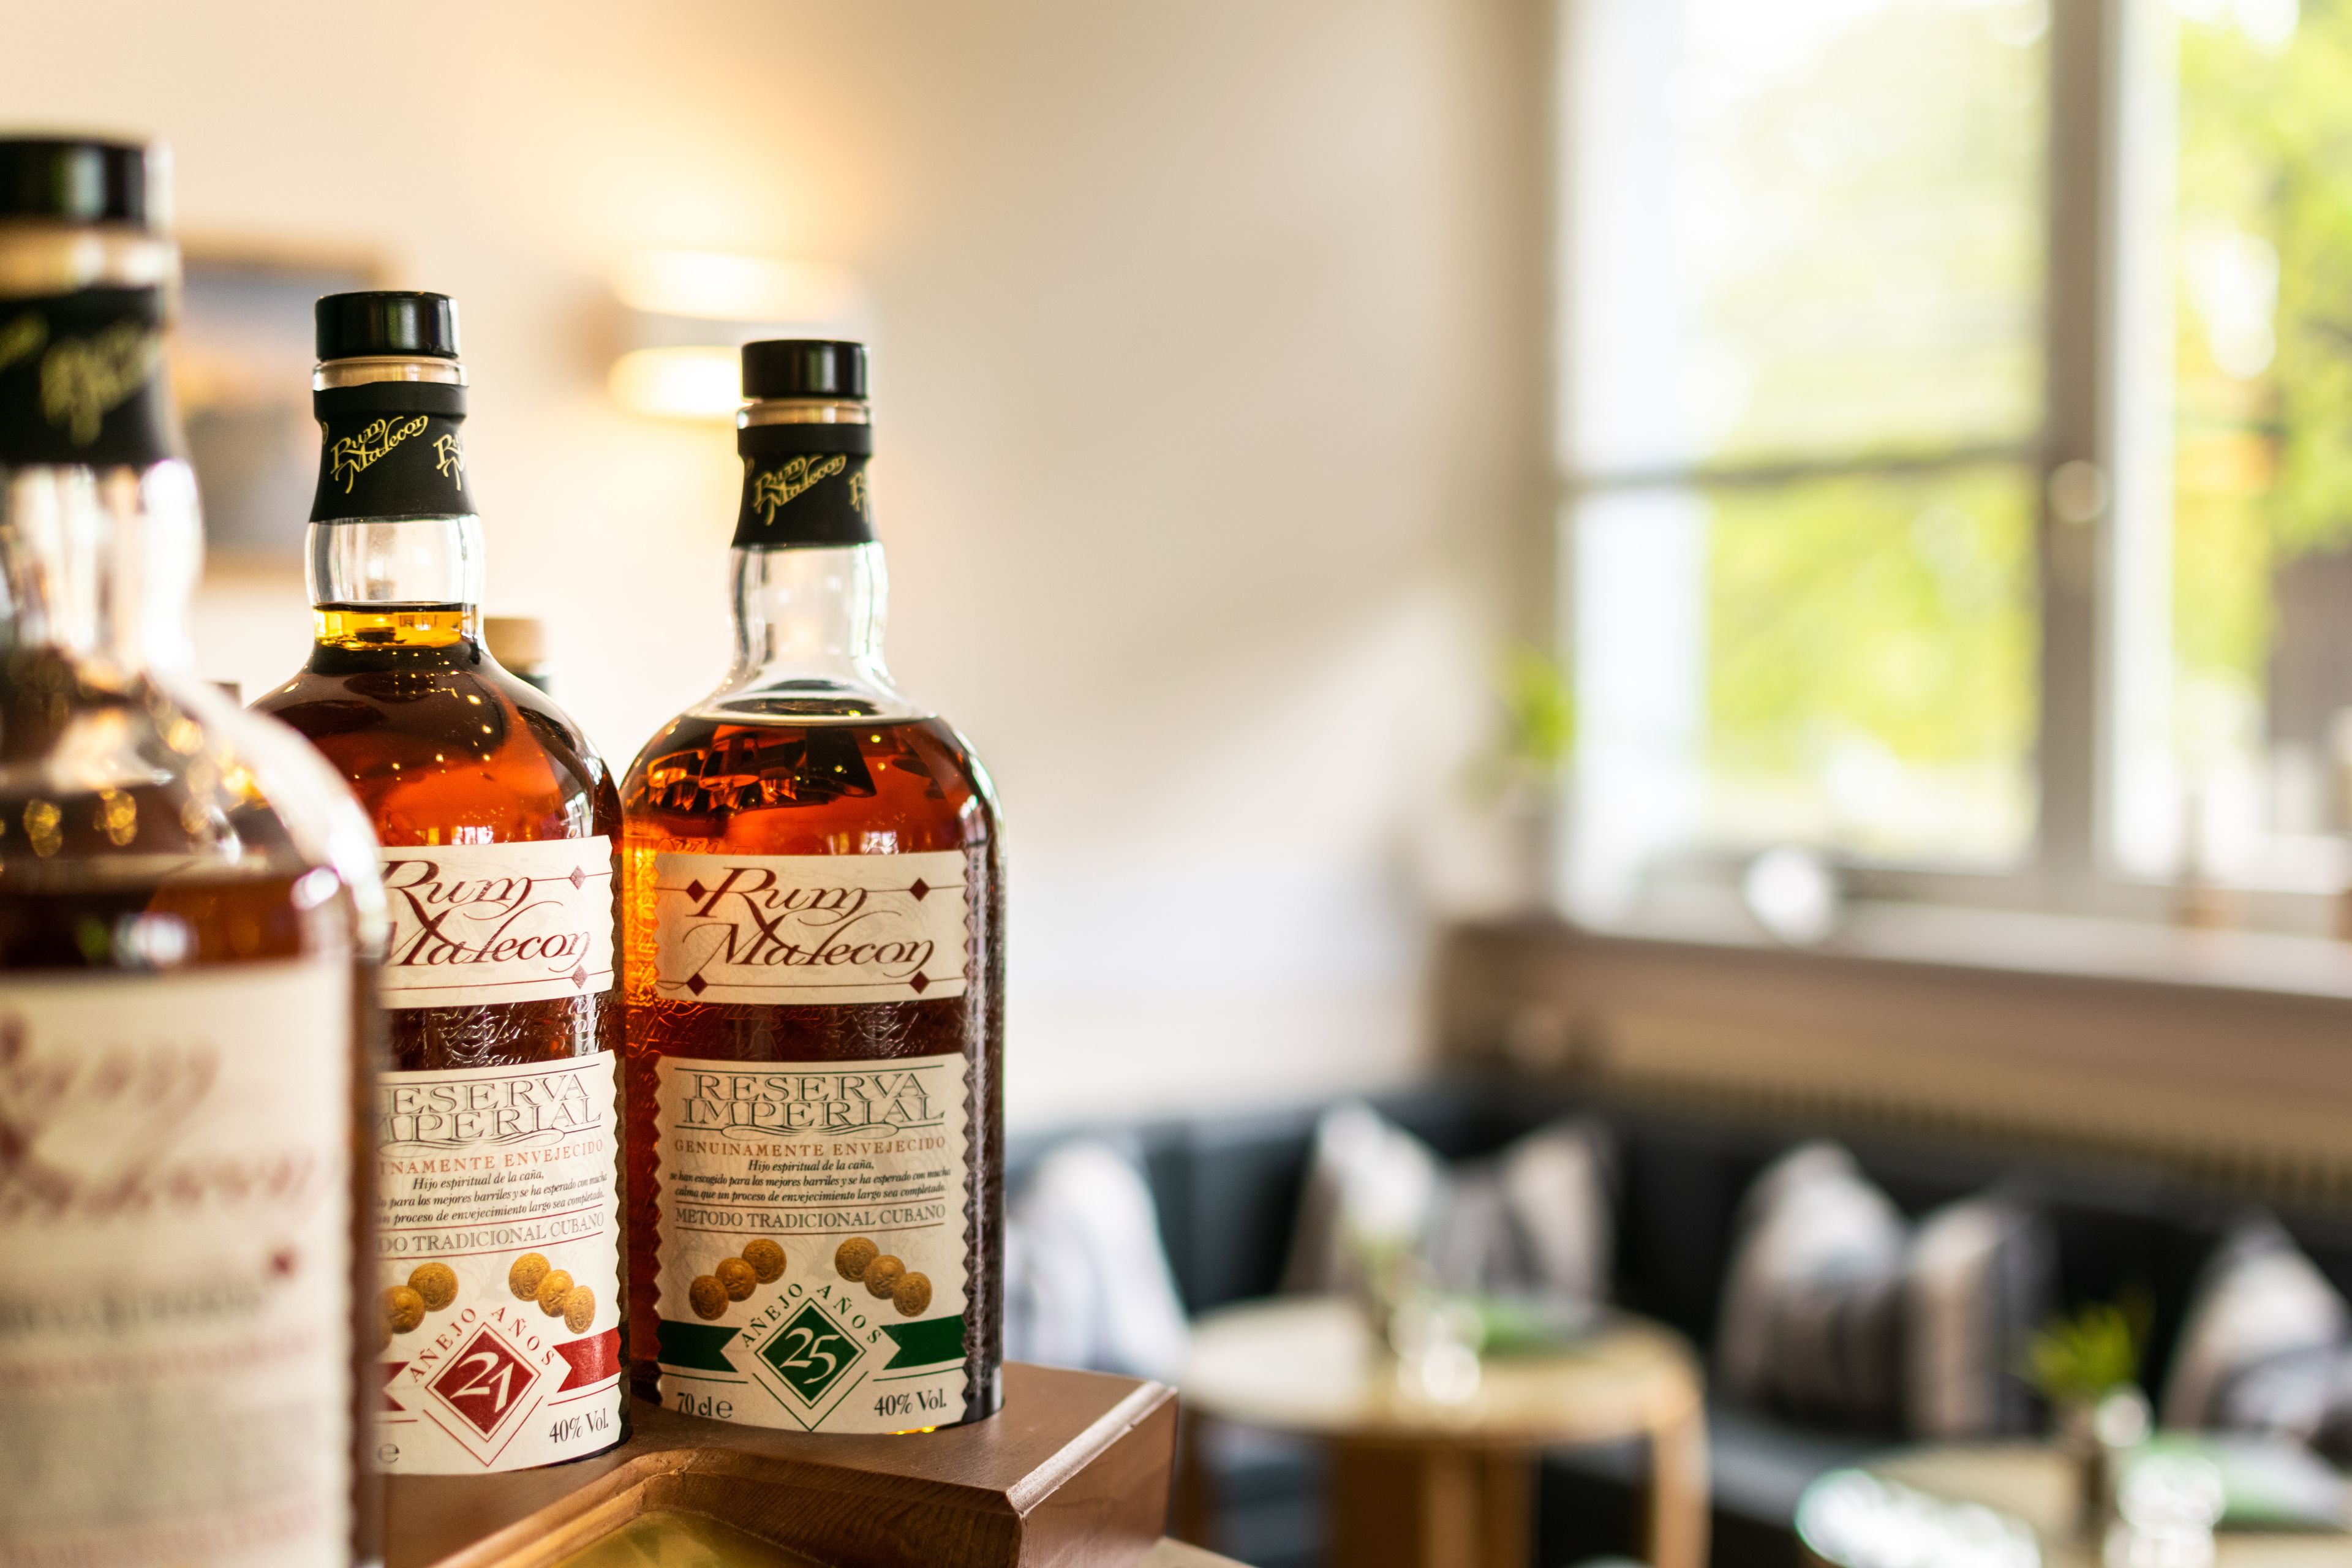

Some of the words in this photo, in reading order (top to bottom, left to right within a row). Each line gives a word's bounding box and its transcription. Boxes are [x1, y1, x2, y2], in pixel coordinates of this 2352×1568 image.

[330, 419, 386, 474] Rum
[334, 415, 428, 494] Malecon
[753, 454, 806, 508] Rum
[756, 454, 846, 526] Malecon
[381, 860, 532, 921] Rum
[686, 867, 868, 929] Rum
[682, 911, 934, 978] Malecon
[387, 1074, 588, 1114] ESERVA
[692, 1073, 929, 1102] RESERVA
[385, 1097, 601, 1141] PERIAL
[682, 1096, 945, 1127] IMPERIAL
[505, 1139, 603, 1167] ENVEJECIDO
[675, 1140, 824, 1157] GENUINAMENTE
[833, 1137, 945, 1156] ENVEJECIDO
[748, 1159, 770, 1173] Hijo
[772, 1160, 820, 1173] espiritual
[822, 1160, 834, 1171] de
[836, 1159, 845, 1170] la
[848, 1159, 874, 1170] caña,
[390, 1198, 415, 1210] para
[418, 1194, 431, 1206] los
[434, 1193, 472, 1207] mejores
[474, 1187, 511, 1202] barriles
[512, 1191, 519, 1200] y
[531, 1185, 541, 1196] ha
[544, 1178, 576, 1196] esperado
[589, 1170, 608, 1185] mucha
[413, 1177, 437, 1191] Hijo
[441, 1172, 491, 1189] espiritual
[494, 1172, 505, 1183] de
[508, 1171, 516, 1183] la
[520, 1169, 544, 1182] caña,
[676, 1185, 698, 1197] calma
[701, 1190, 716, 1200] que
[718, 1191, 729, 1200] un
[731, 1192, 766, 1202] proceso
[767, 1191, 778, 1201] de
[782, 1191, 854, 1204] envejecimiento
[858, 1189, 881, 1200] largo
[900, 1182, 946, 1197] completado.
[678, 1170, 693, 1182] han
[695, 1174, 727, 1186] escogido
[728, 1177, 750, 1187] para
[752, 1175, 764, 1186] los
[766, 1177, 801, 1188] mejores
[804, 1174, 839, 1186] barriles
[840, 1178, 847, 1187] y
[859, 1174, 870, 1184] ha
[873, 1170, 911, 1186] esperado
[913, 1172, 925, 1181] con
[927, 1166, 951, 1178] mucha
[394, 1215, 433, 1226] proceso
[436, 1209, 449, 1221] de
[451, 1204, 527, 1221] envejecimiento
[529, 1201, 551, 1213] largo
[568, 1188, 604, 1206] completado.
[676, 1207, 743, 1226] METODO
[747, 1211, 876, 1228] TRADICIONAL
[880, 1204, 946, 1224] CUBANO
[412, 1225, 546, 1251] TRADICIONAL
[550, 1212, 604, 1237] CUBANO
[741, 1283, 804, 1348] AÑEJO
[816, 1284, 882, 1344] AÑOS
[408, 1308, 476, 1382] AÑEJO
[491, 1307, 554, 1365] AÑOS
[778, 1327, 841, 1384] 25
[449, 1352, 514, 1413] 21
[874, 1393, 913, 1416] 40%
[916, 1387, 947, 1411] Vol.
[677, 1392, 695, 1414] 70
[549, 1415, 582, 1443] 40%
[586, 1408, 609, 1433] Vol.
